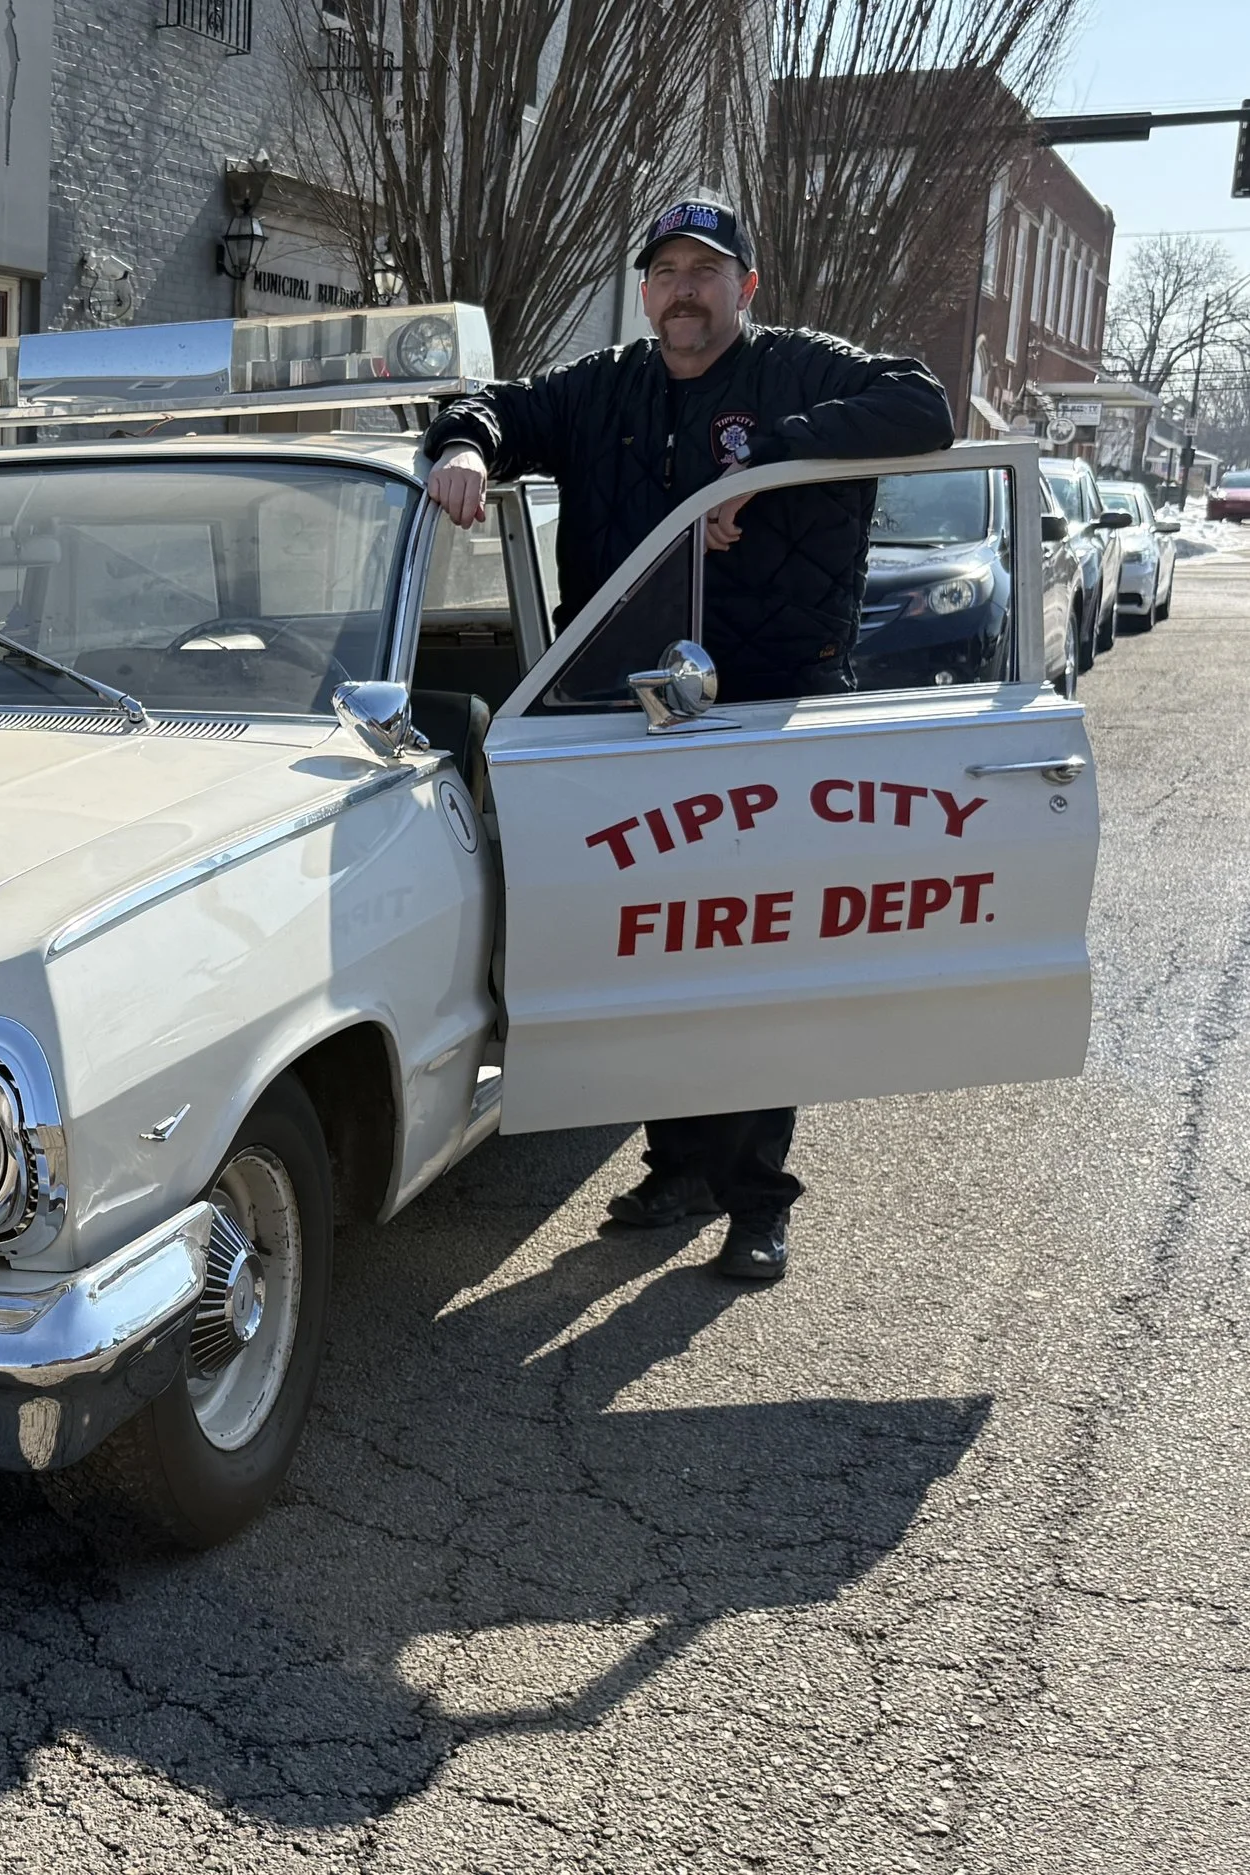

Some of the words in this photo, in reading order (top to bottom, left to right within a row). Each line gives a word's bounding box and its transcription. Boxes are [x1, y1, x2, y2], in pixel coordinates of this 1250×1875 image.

[686, 204, 719, 216] CITY
[253, 270, 312, 301] MUNICIPAL
[317, 283, 364, 310] BUILDING
[715, 415, 735, 427] TIPP
[736, 416, 755, 427] CITY
[448, 792, 471, 841] 1
[585, 783, 779, 870] TIPP
[809, 778, 988, 838] CITY
[616, 890, 793, 957] FIRE
[819, 872, 995, 938] DEPT.
